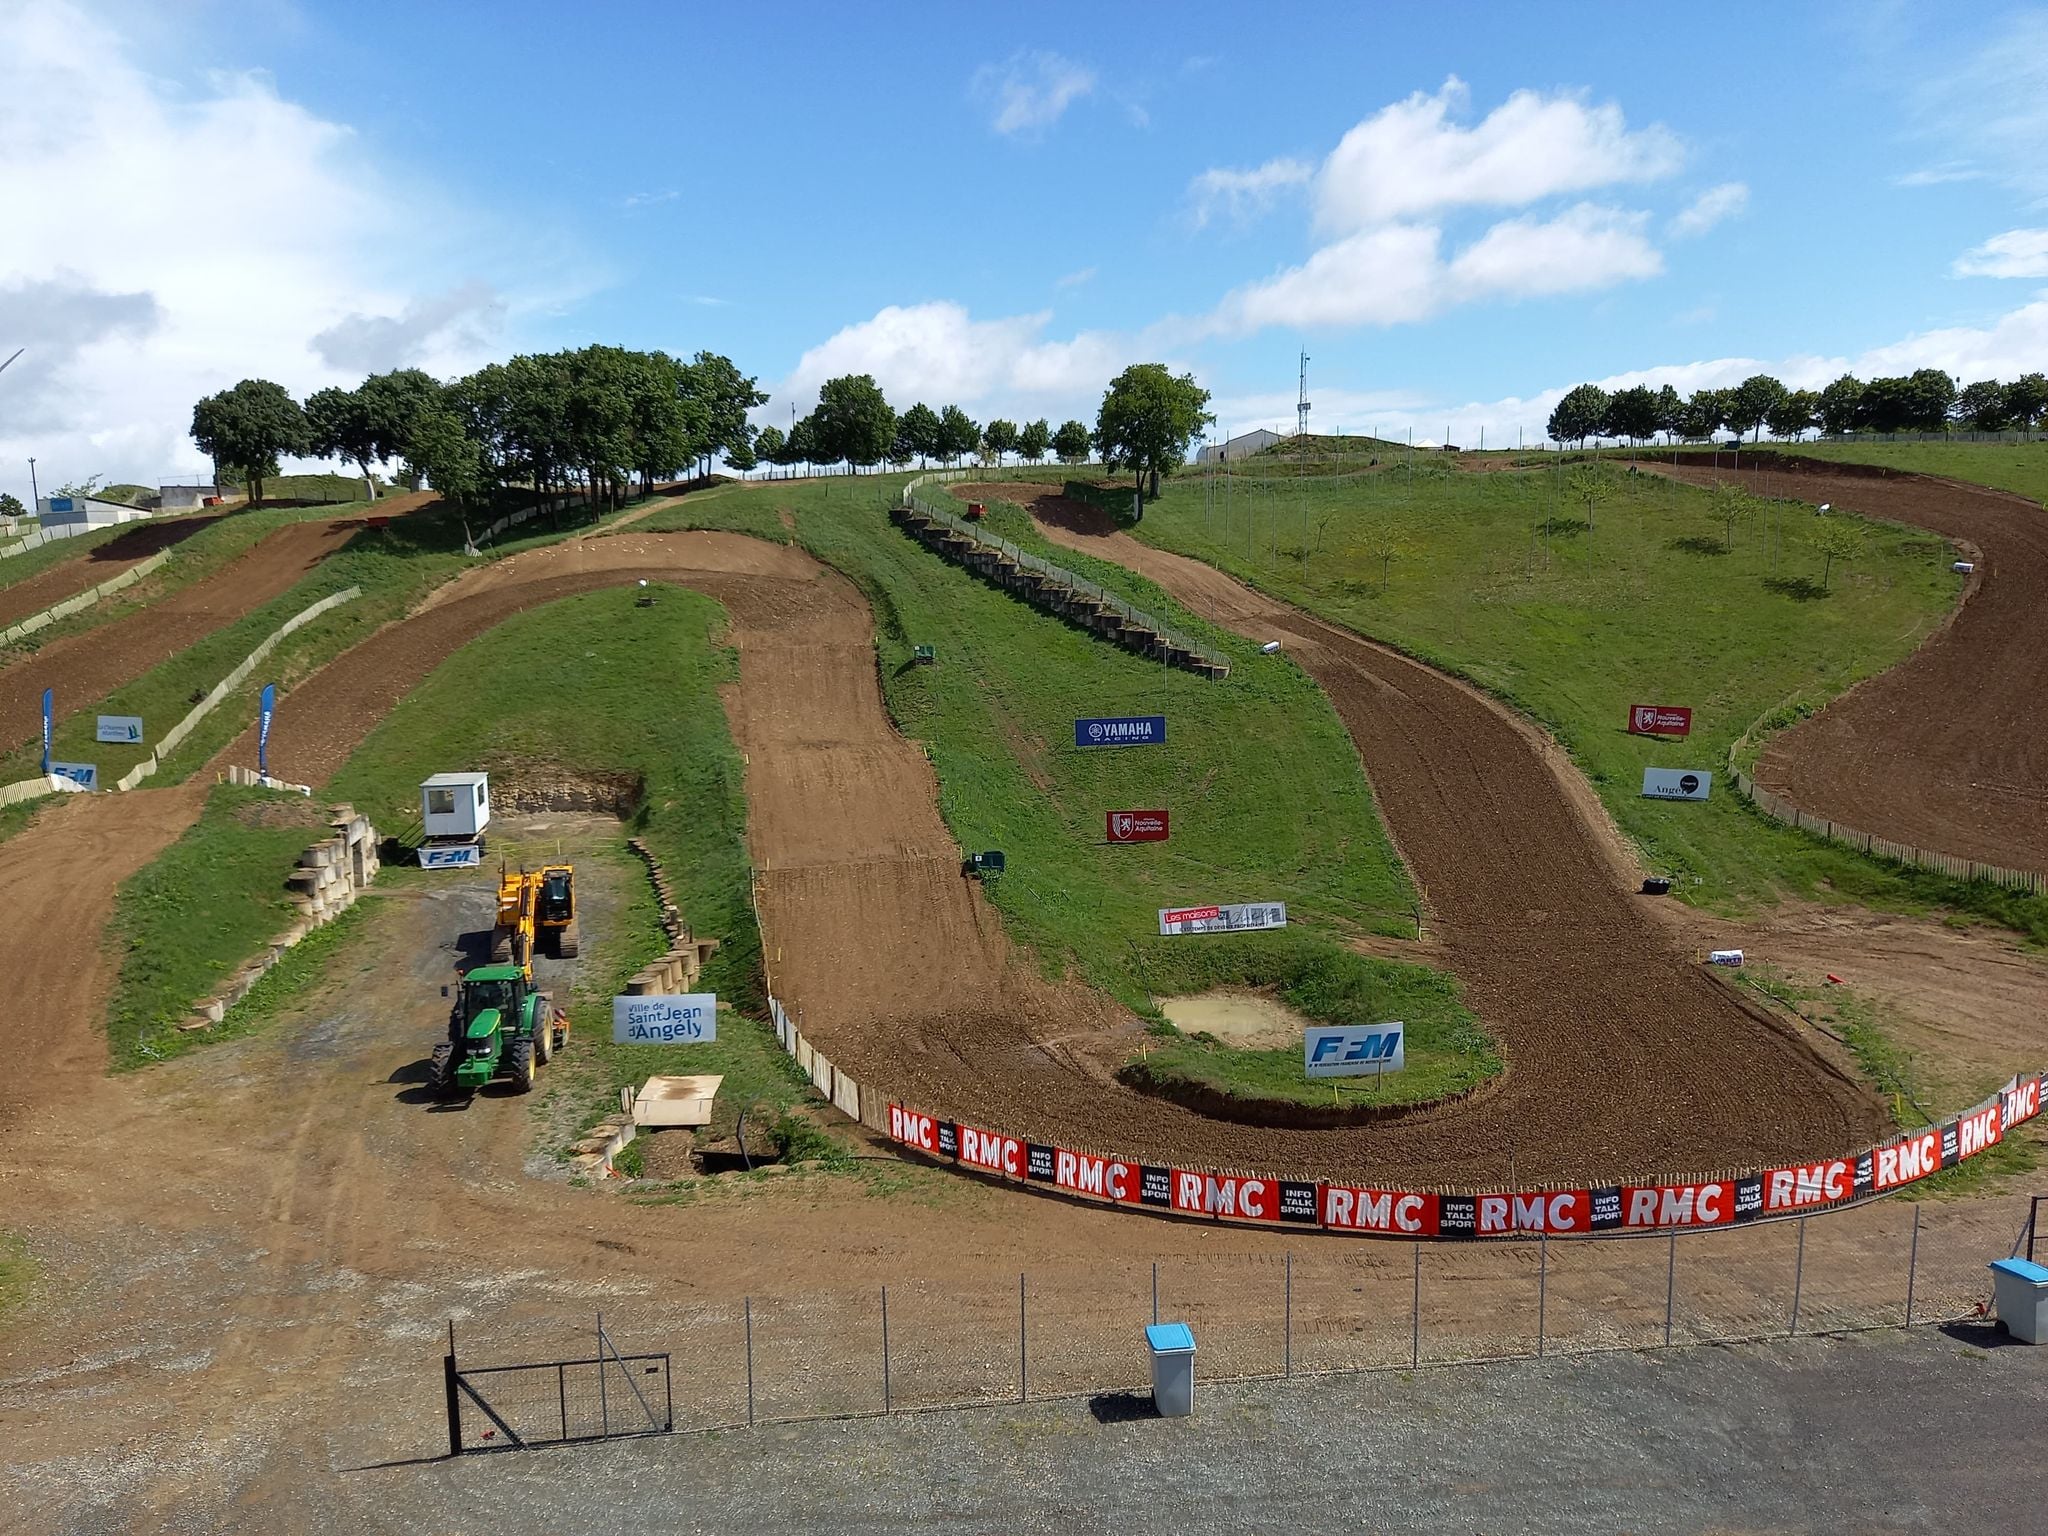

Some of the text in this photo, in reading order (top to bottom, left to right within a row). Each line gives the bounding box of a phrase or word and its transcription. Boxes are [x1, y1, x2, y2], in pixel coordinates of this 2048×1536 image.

[1103, 722, 1152, 736] YAMAHA
[1183, 909, 1218, 920] maisons
[628, 1002, 665, 1012] Ville de
[628, 1019, 702, 1041] d'Angély
[2008, 1082, 2036, 1126] RMC
[892, 1107, 932, 1149] RMC
[1960, 1108, 1997, 1157] RMC
[963, 1128, 1018, 1174] RMC
[1031, 1151, 1051, 1160] INFO
[1031, 1159, 1052, 1168] TALK
[1878, 1135, 1935, 1187] RMC
[1028, 1166, 1053, 1176] SPORT
[1057, 1151, 1128, 1199] RMC
[1146, 1174, 1168, 1183] INFO
[1145, 1182, 1169, 1192] TALK
[1740, 1184, 1761, 1195] INFO
[1769, 1162, 1846, 1208] RMC
[1141, 1189, 1171, 1200] SPORT
[1179, 1172, 1265, 1217] RMC
[1286, 1190, 1311, 1198] INFO
[1739, 1193, 1761, 1203] TALK
[1285, 1198, 1312, 1207] TALK
[1595, 1196, 1619, 1205] INFO
[1628, 1184, 1723, 1225] RMC
[1735, 1200, 1763, 1212] SPORT
[1280, 1206, 1316, 1215] SPORT
[1325, 1188, 1424, 1232] RMC
[1480, 1194, 1576, 1231] RMC
[1594, 1204, 1620, 1213] TALK
[1445, 1212, 1474, 1220] TALK
[1590, 1211, 1623, 1222] SPORT
[1440, 1220, 1476, 1228] SPORT
